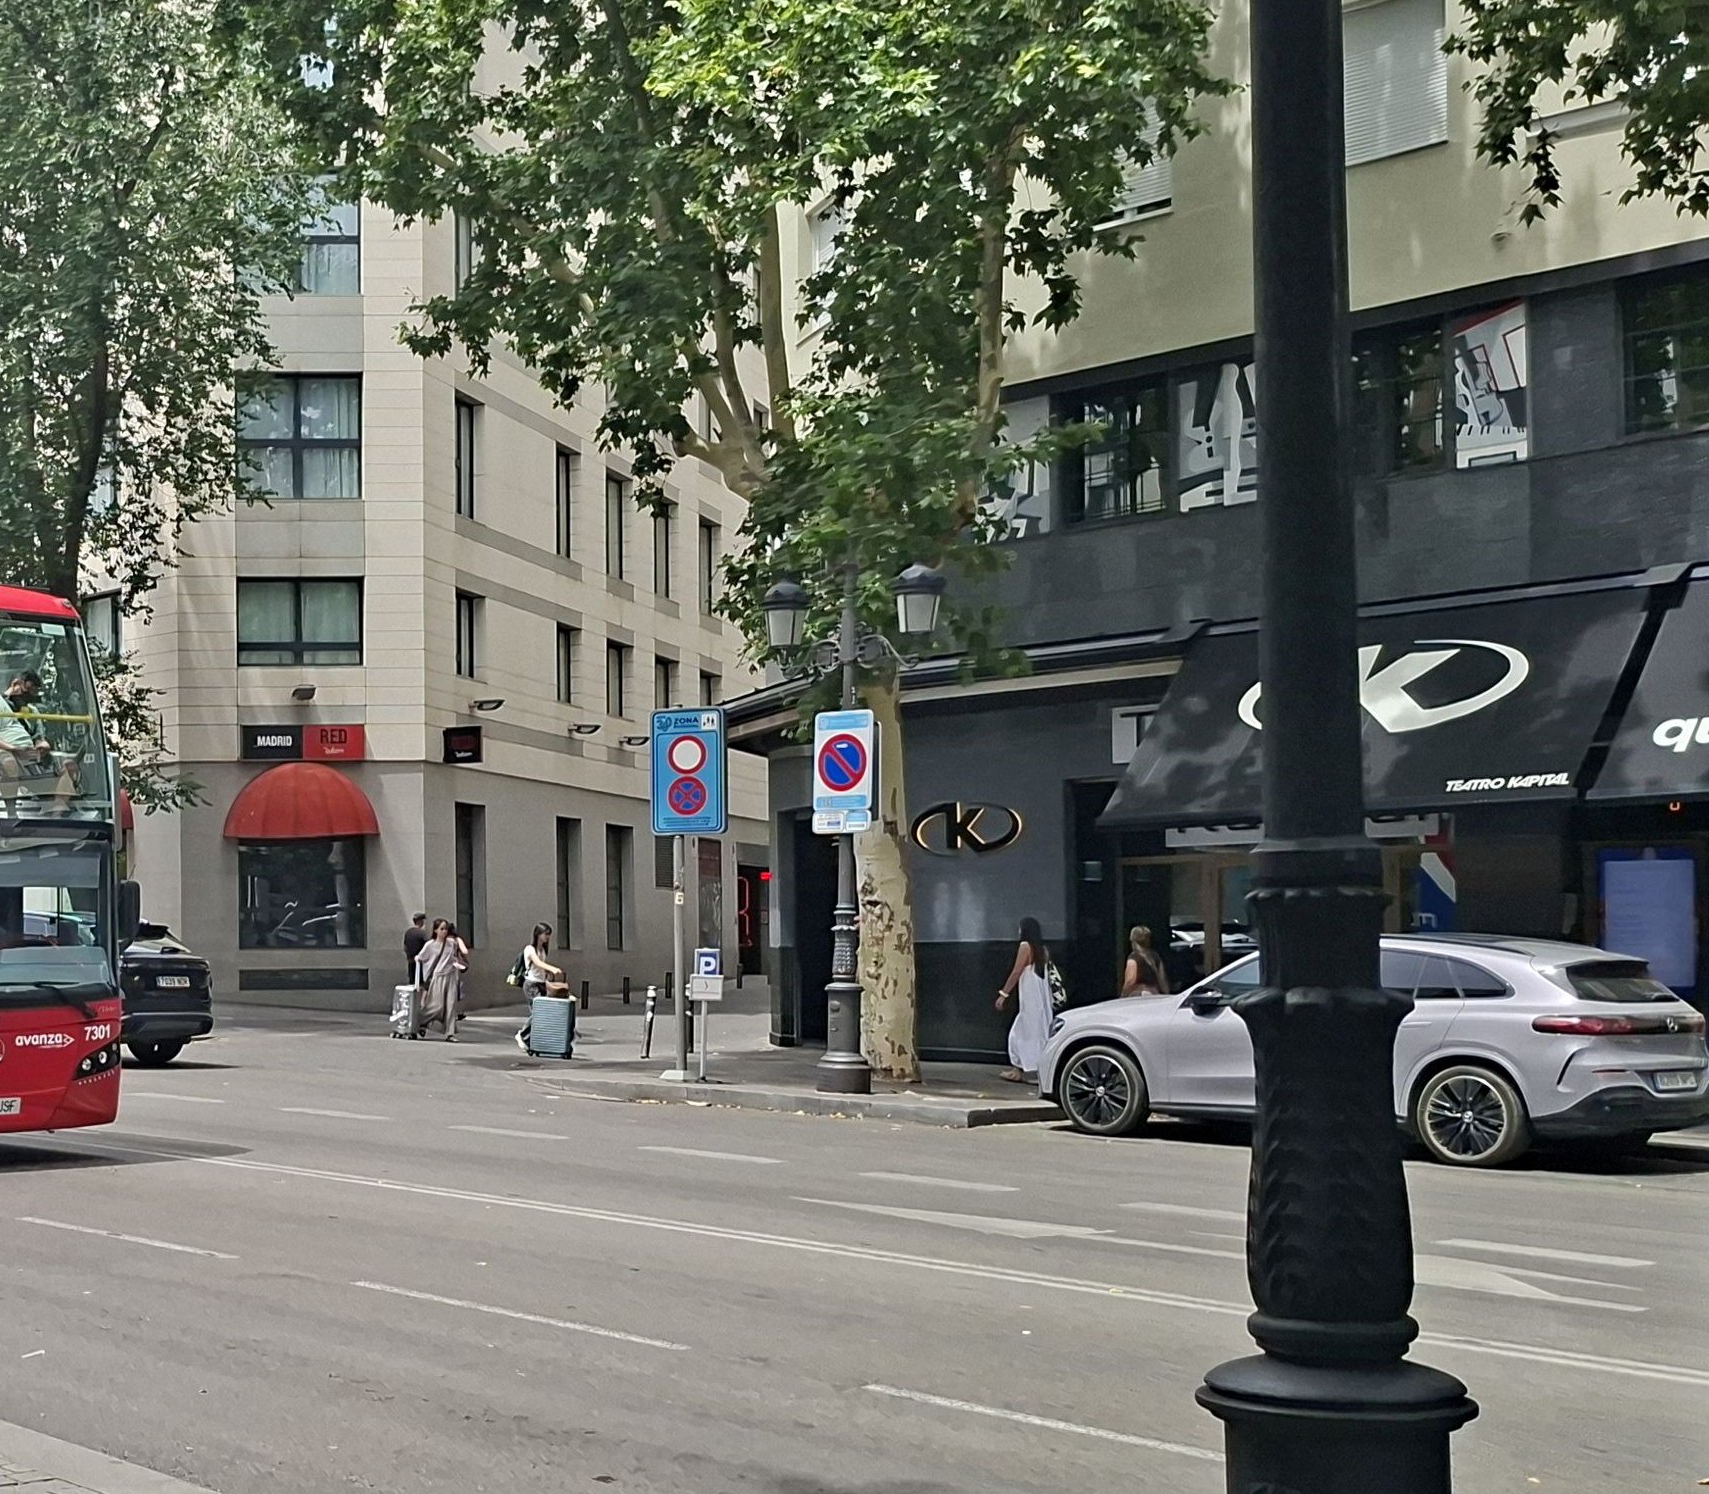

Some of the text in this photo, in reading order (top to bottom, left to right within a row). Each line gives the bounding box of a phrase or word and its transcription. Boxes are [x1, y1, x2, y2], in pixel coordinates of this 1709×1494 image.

[674, 717, 699, 725] ZONA
[257, 736, 293, 747] MADRID
[320, 728, 348, 744] RED
[1445, 773, 1570, 792] TEATRO KAPITAL
[700, 956, 716, 975] P
[15, 1033, 63, 1046] avanza
[84, 1024, 111, 1041] 7301
